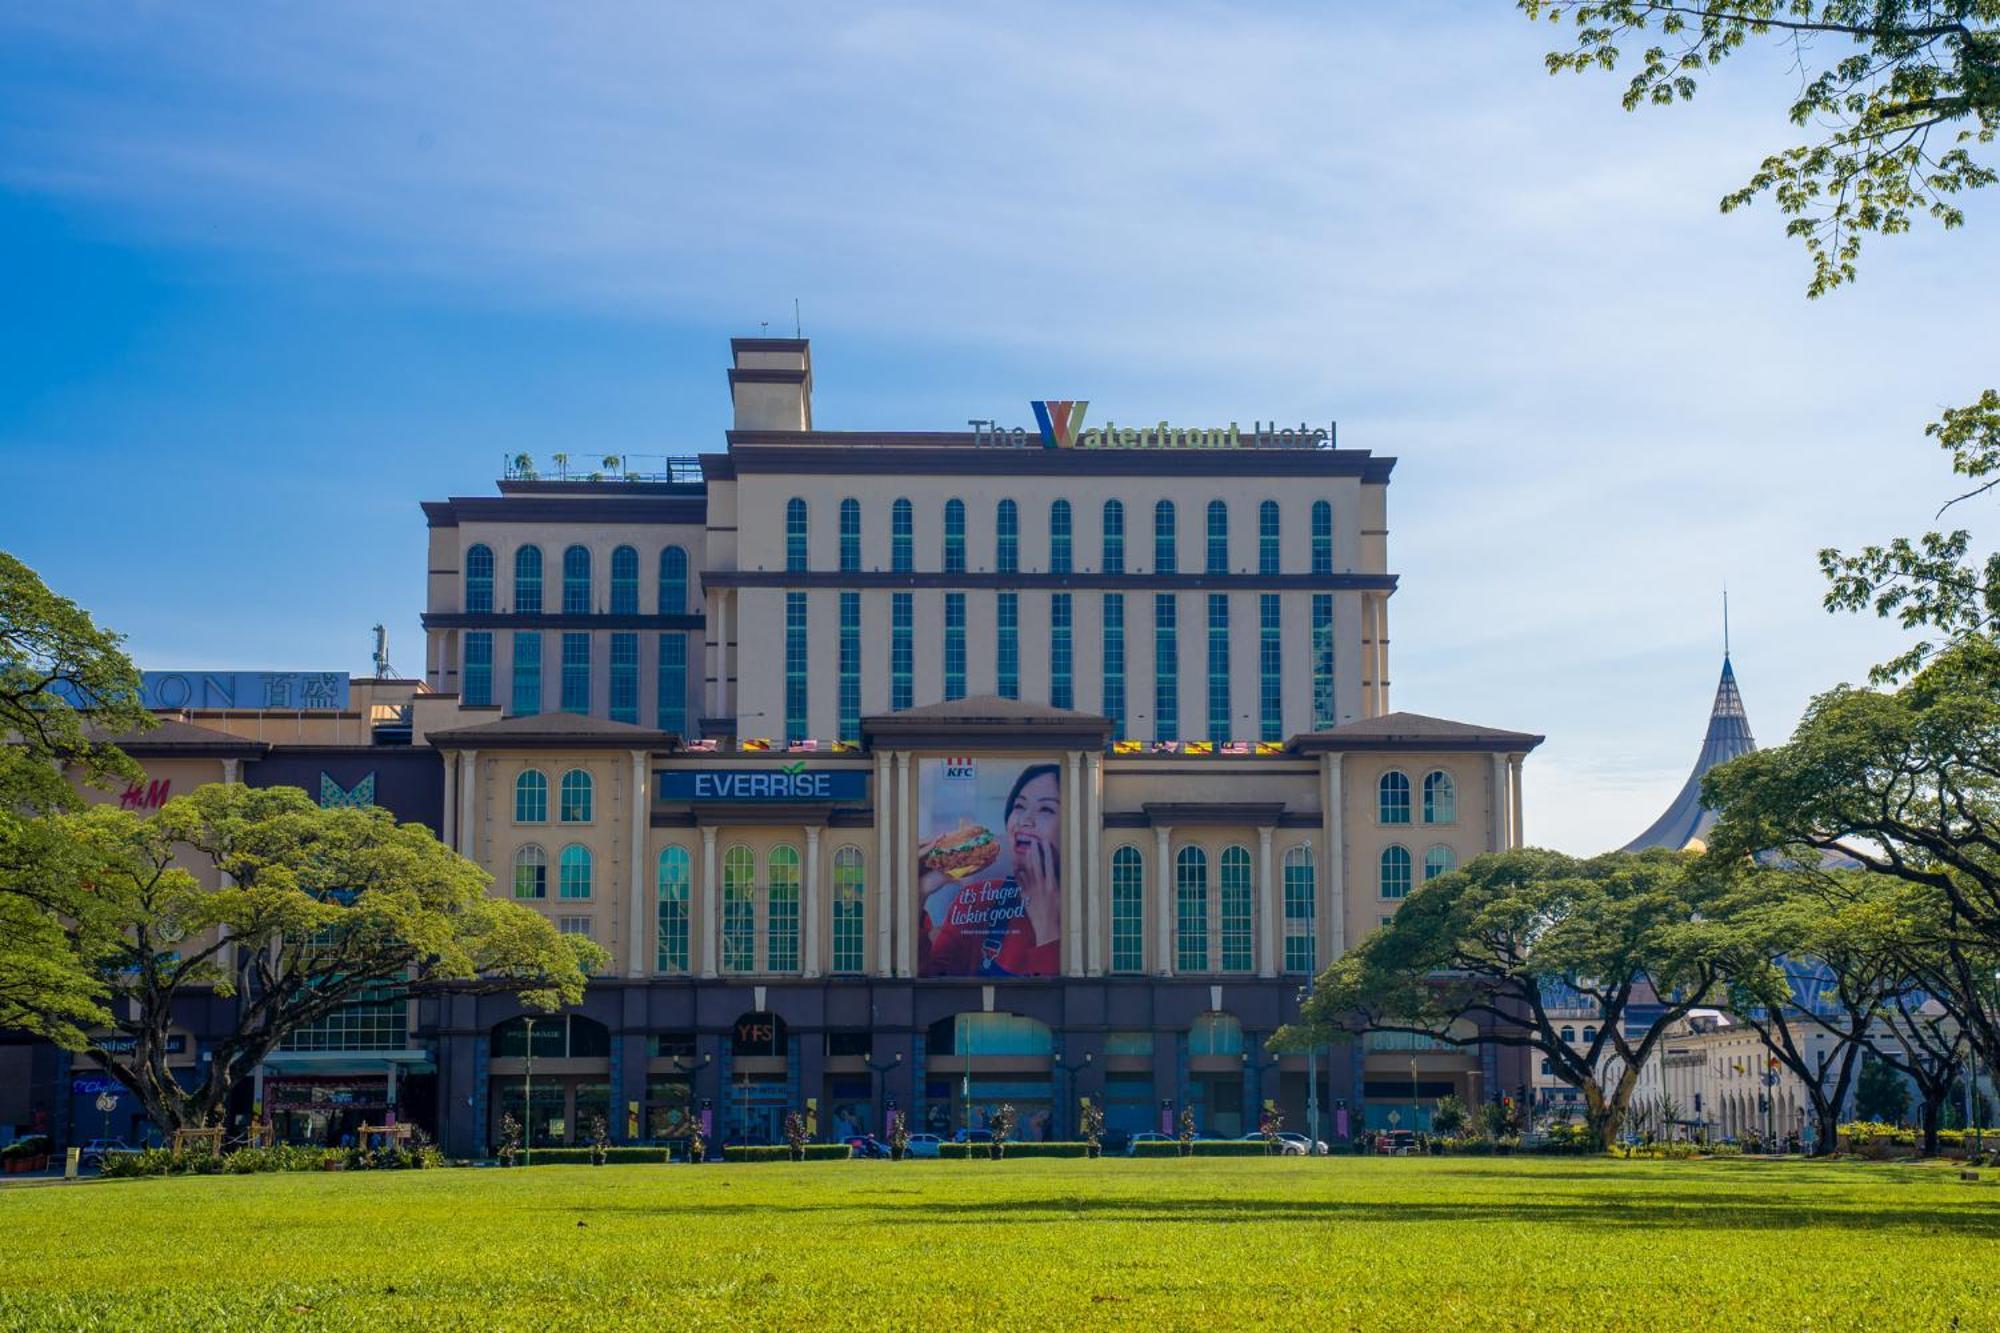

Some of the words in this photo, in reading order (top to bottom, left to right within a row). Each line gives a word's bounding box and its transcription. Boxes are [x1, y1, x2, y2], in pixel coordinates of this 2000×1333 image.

[968, 420, 1027, 449] The
[1030, 400, 1241, 450] Waterfront
[1255, 420, 1337, 449] Hotel
[946, 768, 974, 777] KFC
[695, 774, 831, 797] EVERRISE
[981, 881, 1022, 906] finger
[989, 901, 1025, 927] good
